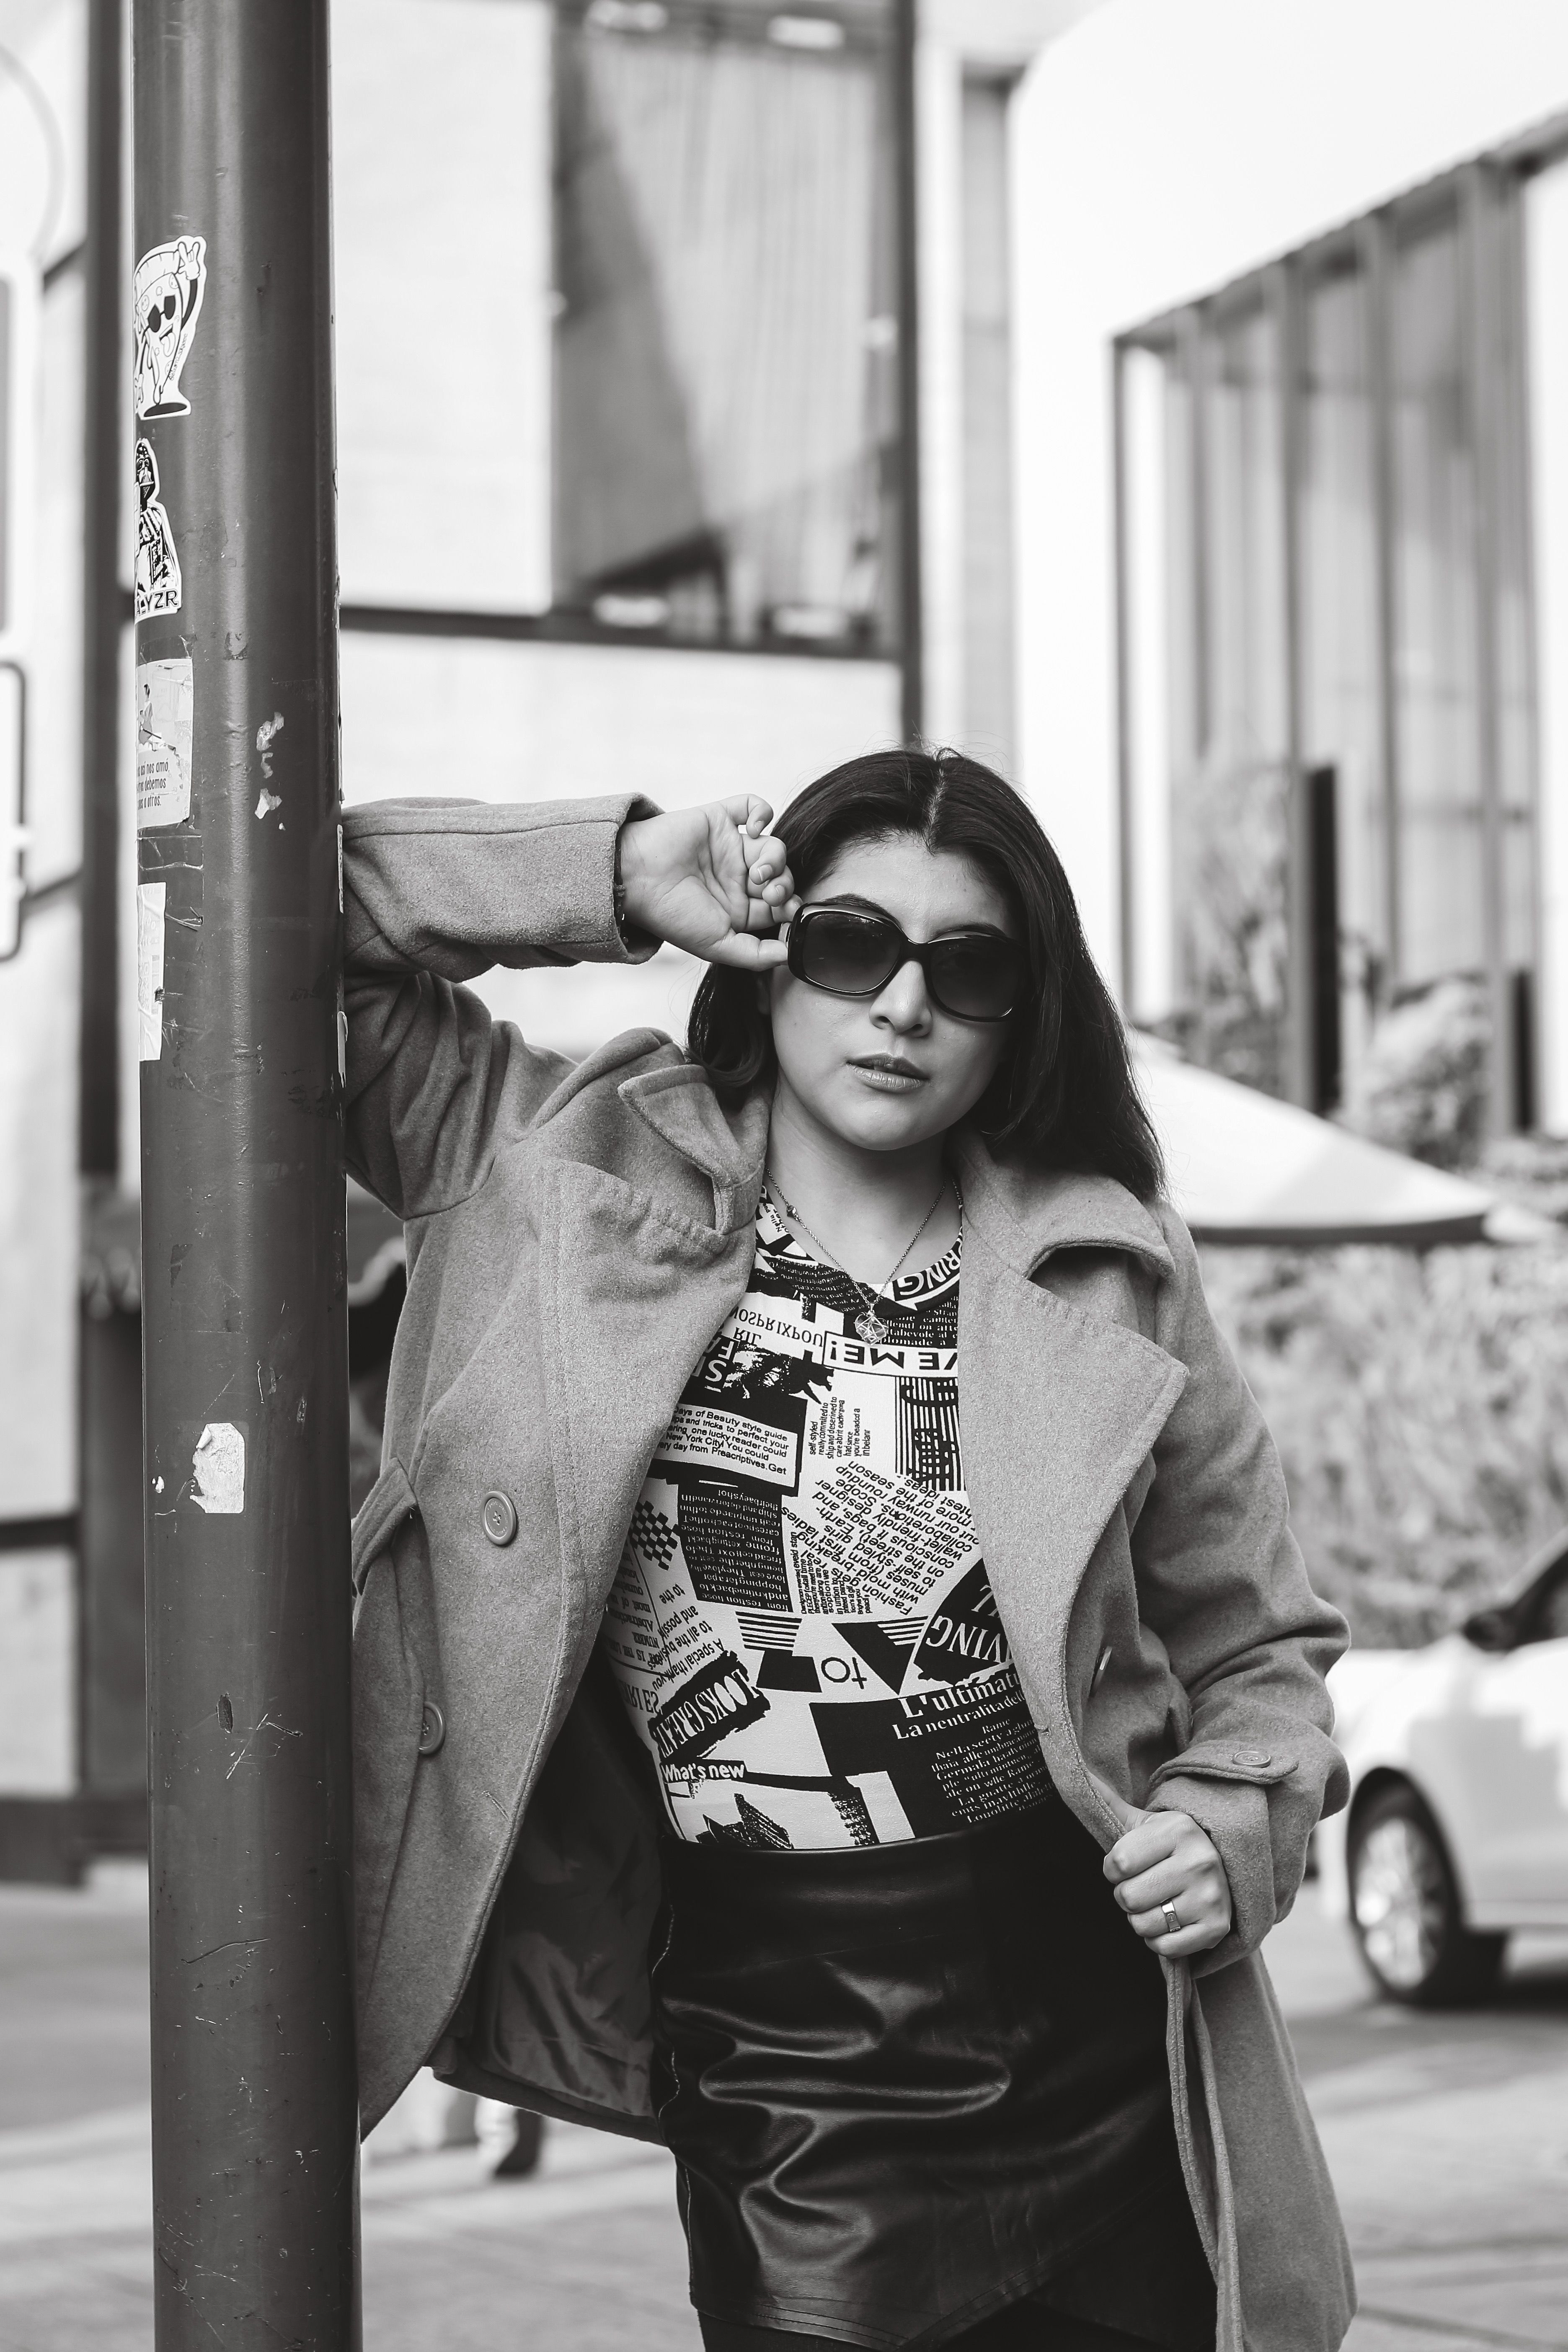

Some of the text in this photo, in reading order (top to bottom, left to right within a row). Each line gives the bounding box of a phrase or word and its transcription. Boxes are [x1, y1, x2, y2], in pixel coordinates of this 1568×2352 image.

[145, 776, 166, 791] debemos
[830, 1340, 904, 1369] ME!
[673, 1442, 688, 1452] day
[690, 1443, 708, 1454] from
[685, 1432, 703, 1443] York
[726, 1440, 743, 1452] You
[745, 1449, 769, 1461] could
[709, 1429, 732, 1442] lucky
[732, 1436, 762, 1450] reader
[763, 1446, 787, 1457] could
[765, 1430, 787, 1441] guide
[765, 1437, 789, 1450] your
[808, 1421, 819, 1455] self-styled
[825, 1446, 836, 1459] ship
[843, 1446, 852, 1456] had
[836, 1466, 888, 1499] roundup
[836, 1479, 877, 1507] Scope
[848, 1461, 972, 1527] more of the season
[812, 1491, 843, 1510] and
[887, 1496, 936, 1523] runway
[781, 1506, 819, 1539] ladies
[815, 1480, 962, 1561] wallet-friendly designer
[843, 1508, 877, 1534] bags,
[935, 1521, 959, 1534] our
[816, 1507, 944, 1577] on the street), Earth-
[819, 1535, 846, 1556] first
[890, 1536, 954, 1569] conscious
[824, 1525, 936, 1588] to self-styled girls
[848, 1552, 884, 1576] (from
[659, 1584, 685, 1604] to the
[800, 1548, 912, 1615] Fashion gets real
[886, 1570, 928, 1596] muses
[893, 1587, 919, 1604] with
[680, 1606, 698, 1624] and
[699, 1621, 713, 1633] to
[674, 1634, 691, 1647] the
[687, 1626, 700, 1642] all
[652, 1638, 727, 1691] A special thank you
[821, 1657, 867, 1689] to
[695, 1668, 760, 1724] LOOKS
[892, 1724, 923, 1739] La
[661, 1763, 745, 1782] What's new
